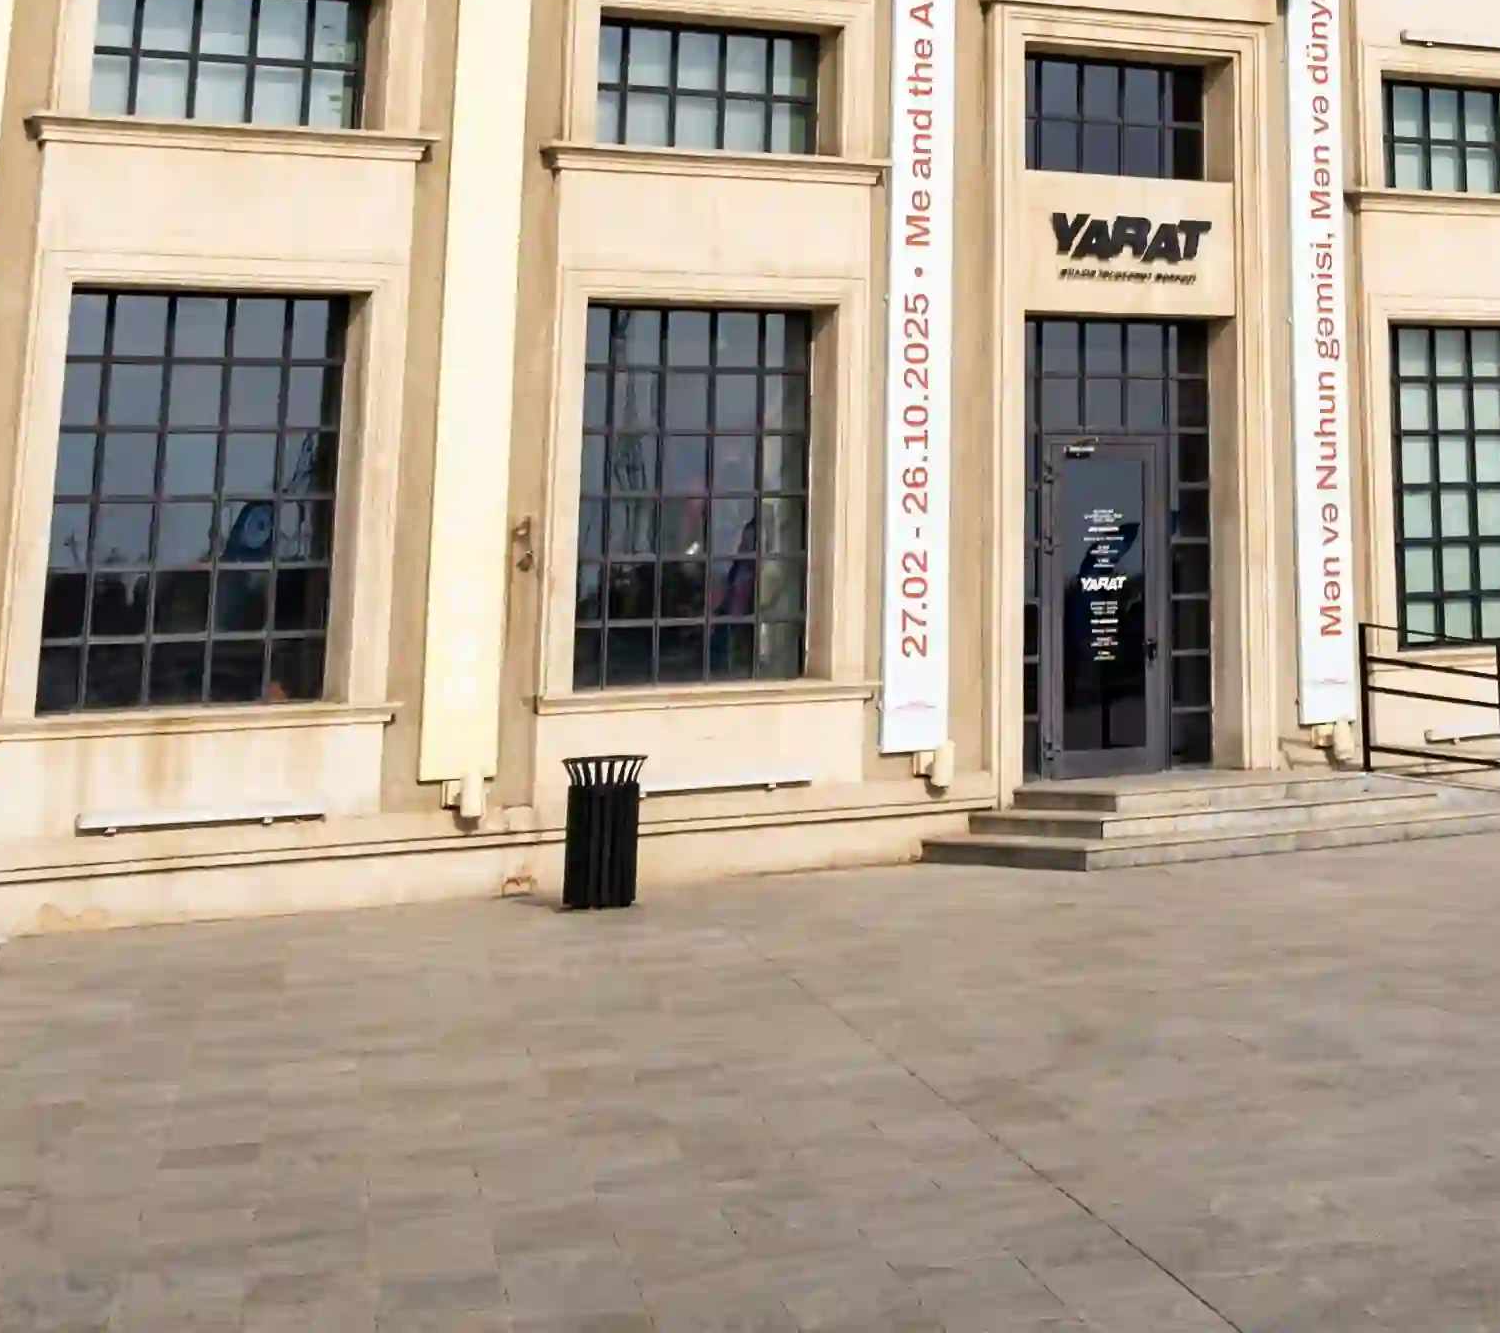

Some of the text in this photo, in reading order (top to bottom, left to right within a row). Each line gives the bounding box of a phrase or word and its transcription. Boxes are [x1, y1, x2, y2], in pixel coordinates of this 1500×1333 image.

[907, 39, 933, 97] the
[907, 109, 932, 180] and
[1310, 145, 1331, 219] Mən
[905, 190, 931, 247] Me
[1052, 212, 1212, 265] YARAT
[902, 294, 929, 514] 26.10.2025
[1314, 372, 1337, 490] Nuhun
[901, 550, 928, 657] 27.02
[1080, 576, 1127, 591] YARAT
[1320, 557, 1342, 637] Mən
